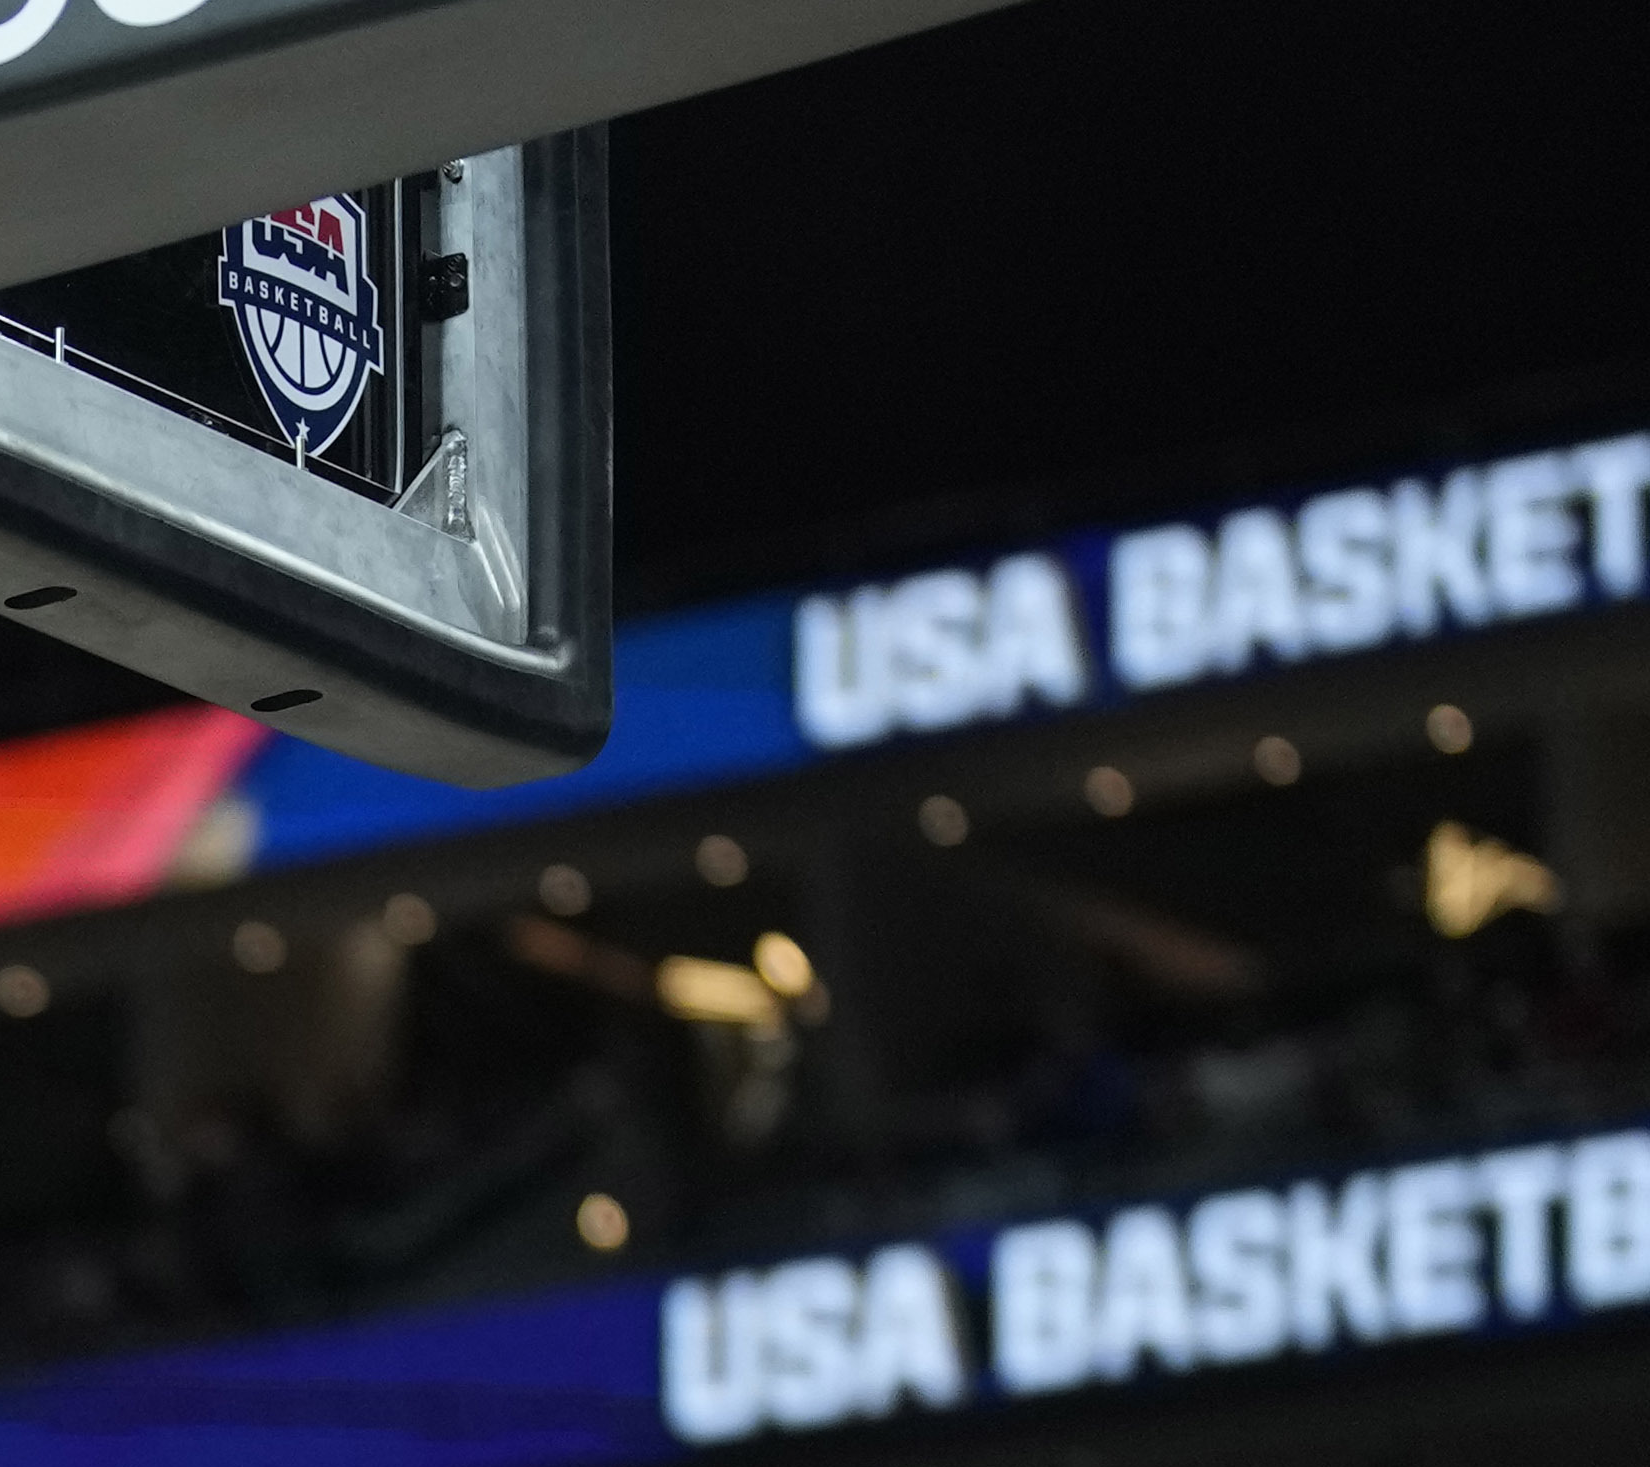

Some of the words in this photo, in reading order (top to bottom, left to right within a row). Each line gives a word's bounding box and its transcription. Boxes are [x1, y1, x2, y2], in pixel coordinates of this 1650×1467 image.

[228, 270, 371, 349] BASKETBALL
[799, 558, 1082, 743] USA
[1114, 438, 1650, 693] BASKET
[666, 1248, 962, 1438] USA
